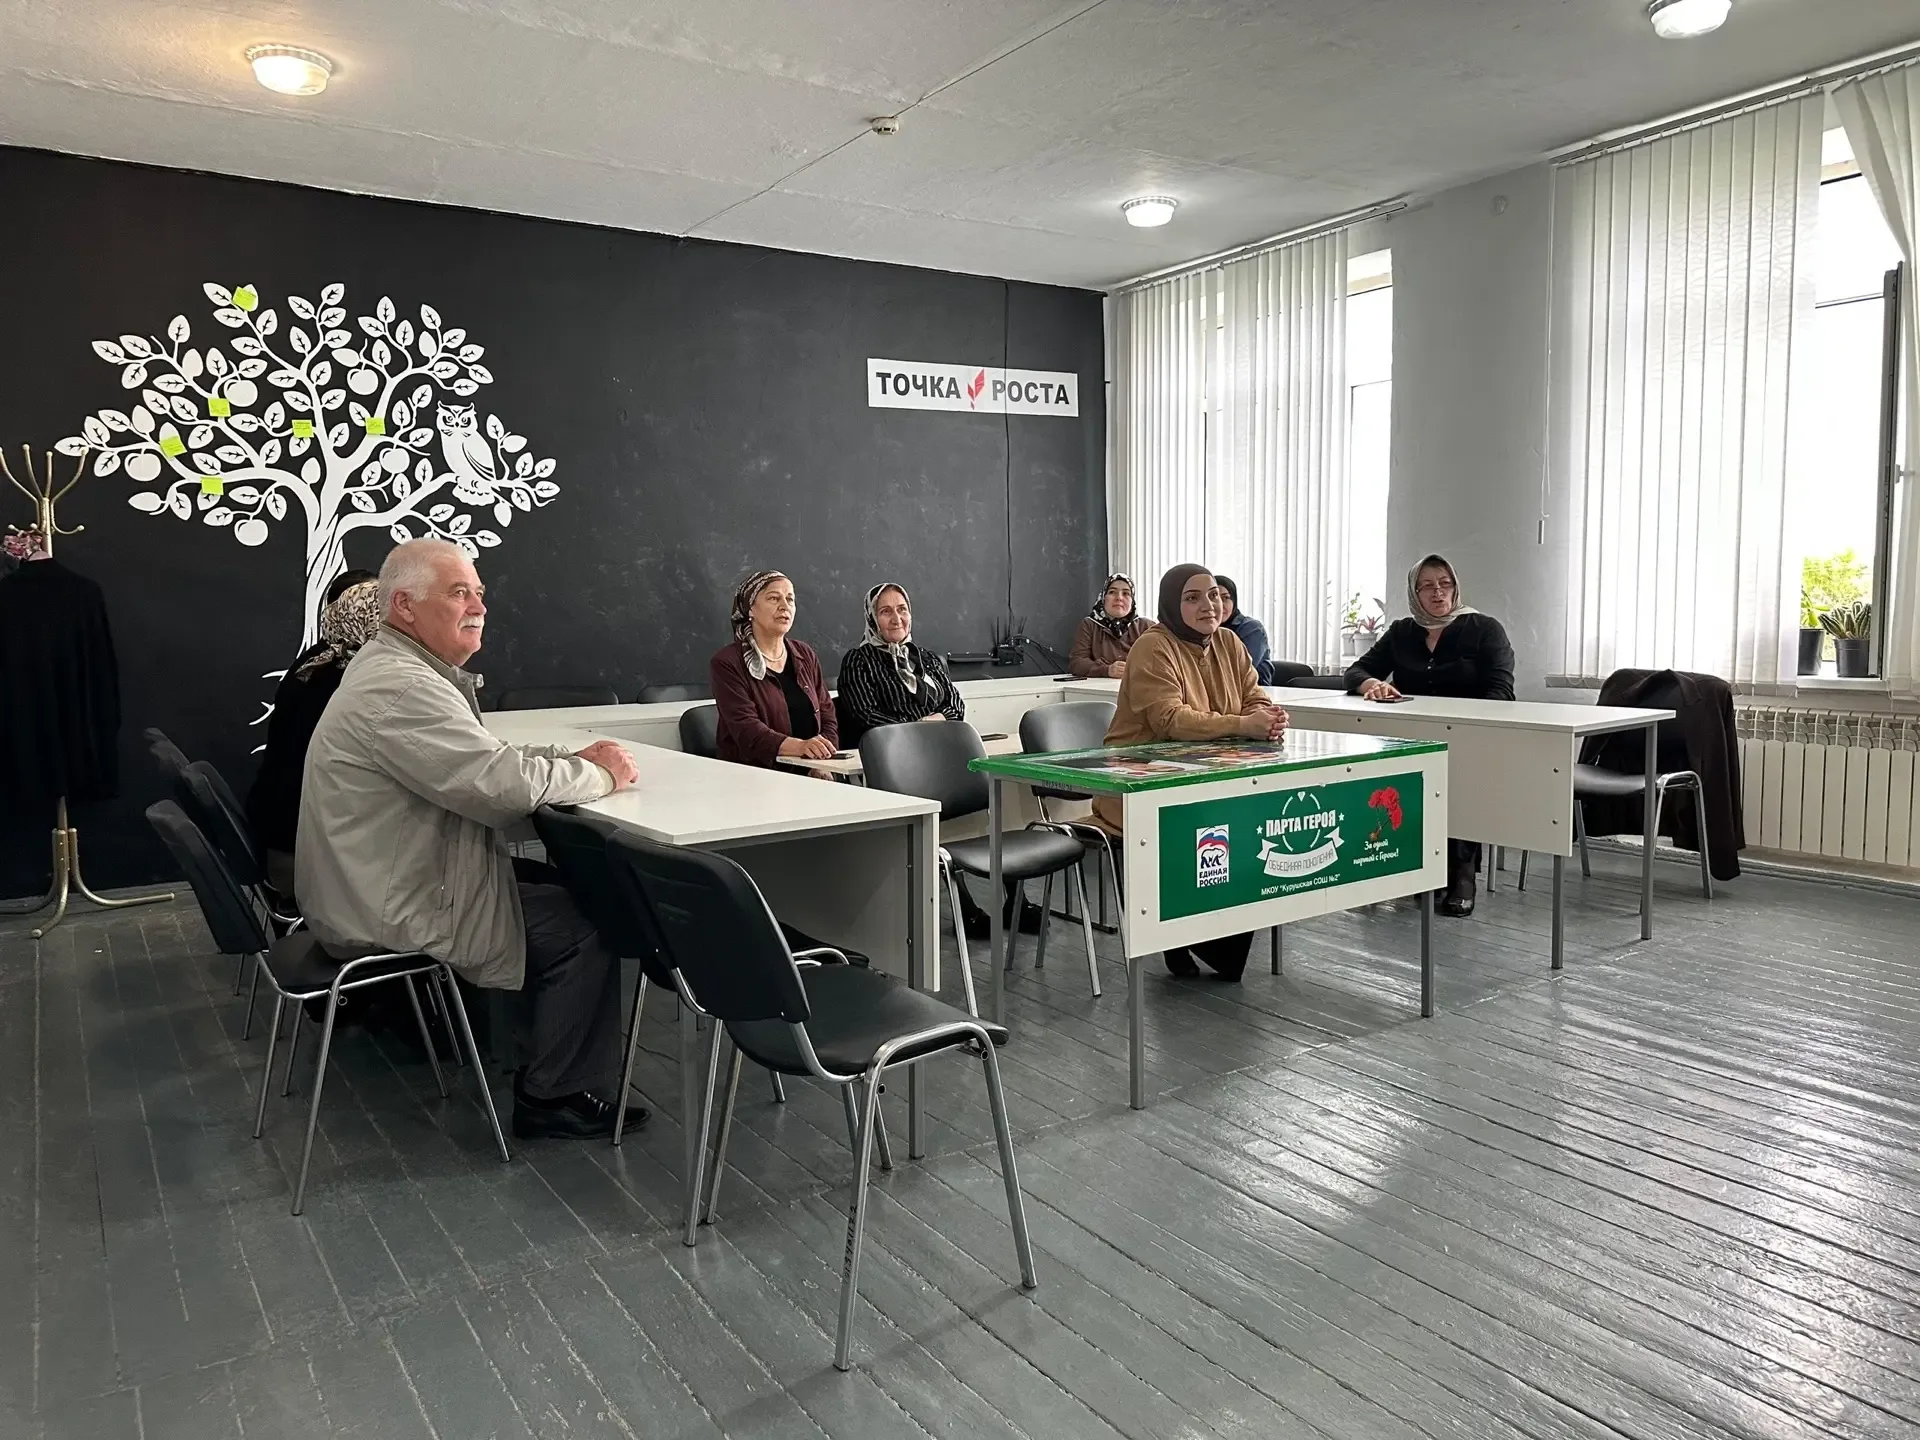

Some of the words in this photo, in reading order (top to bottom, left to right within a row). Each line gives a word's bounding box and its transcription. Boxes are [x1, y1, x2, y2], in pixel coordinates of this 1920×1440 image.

[876, 372, 961, 399] ТОЧКА
[992, 380, 1070, 405] РОСТА
[1265, 817, 1302, 837] ПАРТА
[1303, 809, 1336, 830] ГЕРОЯ
[1364, 840, 1372, 850] За
[1303, 848, 1334, 869] ПОКОЛЕНИЯ
[1199, 867, 1228, 879] ЕДИНАЯ
[1199, 875, 1228, 887] РОССИЯ
[1261, 885, 1279, 896] МКОУ
[1313, 875, 1328, 885] СОШ
